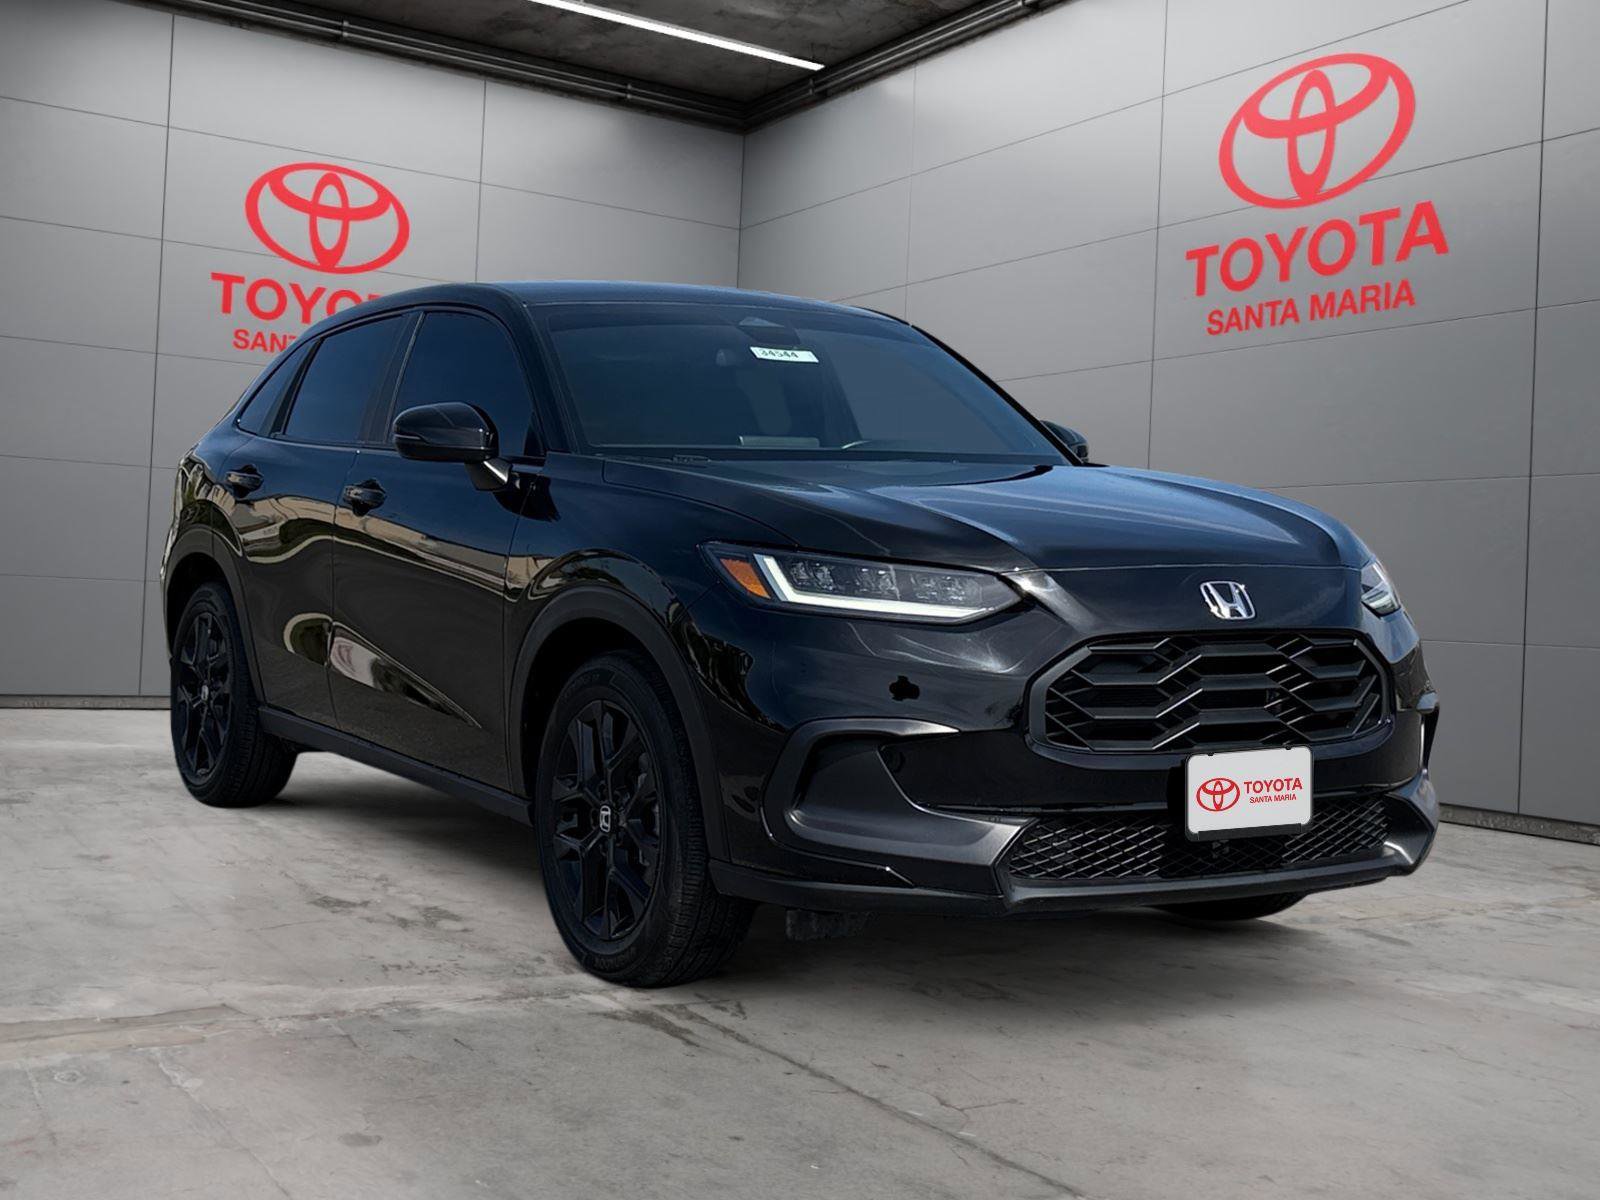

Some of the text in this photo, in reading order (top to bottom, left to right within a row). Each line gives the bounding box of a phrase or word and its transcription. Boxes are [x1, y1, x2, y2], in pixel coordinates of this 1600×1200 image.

[1185, 201, 1449, 297] TOYOTA
[1206, 279, 1415, 336] SANTA MARIA
[1243, 777, 1303, 794] TOYOTA
[1249, 793, 1297, 804] SANTA MARIA
